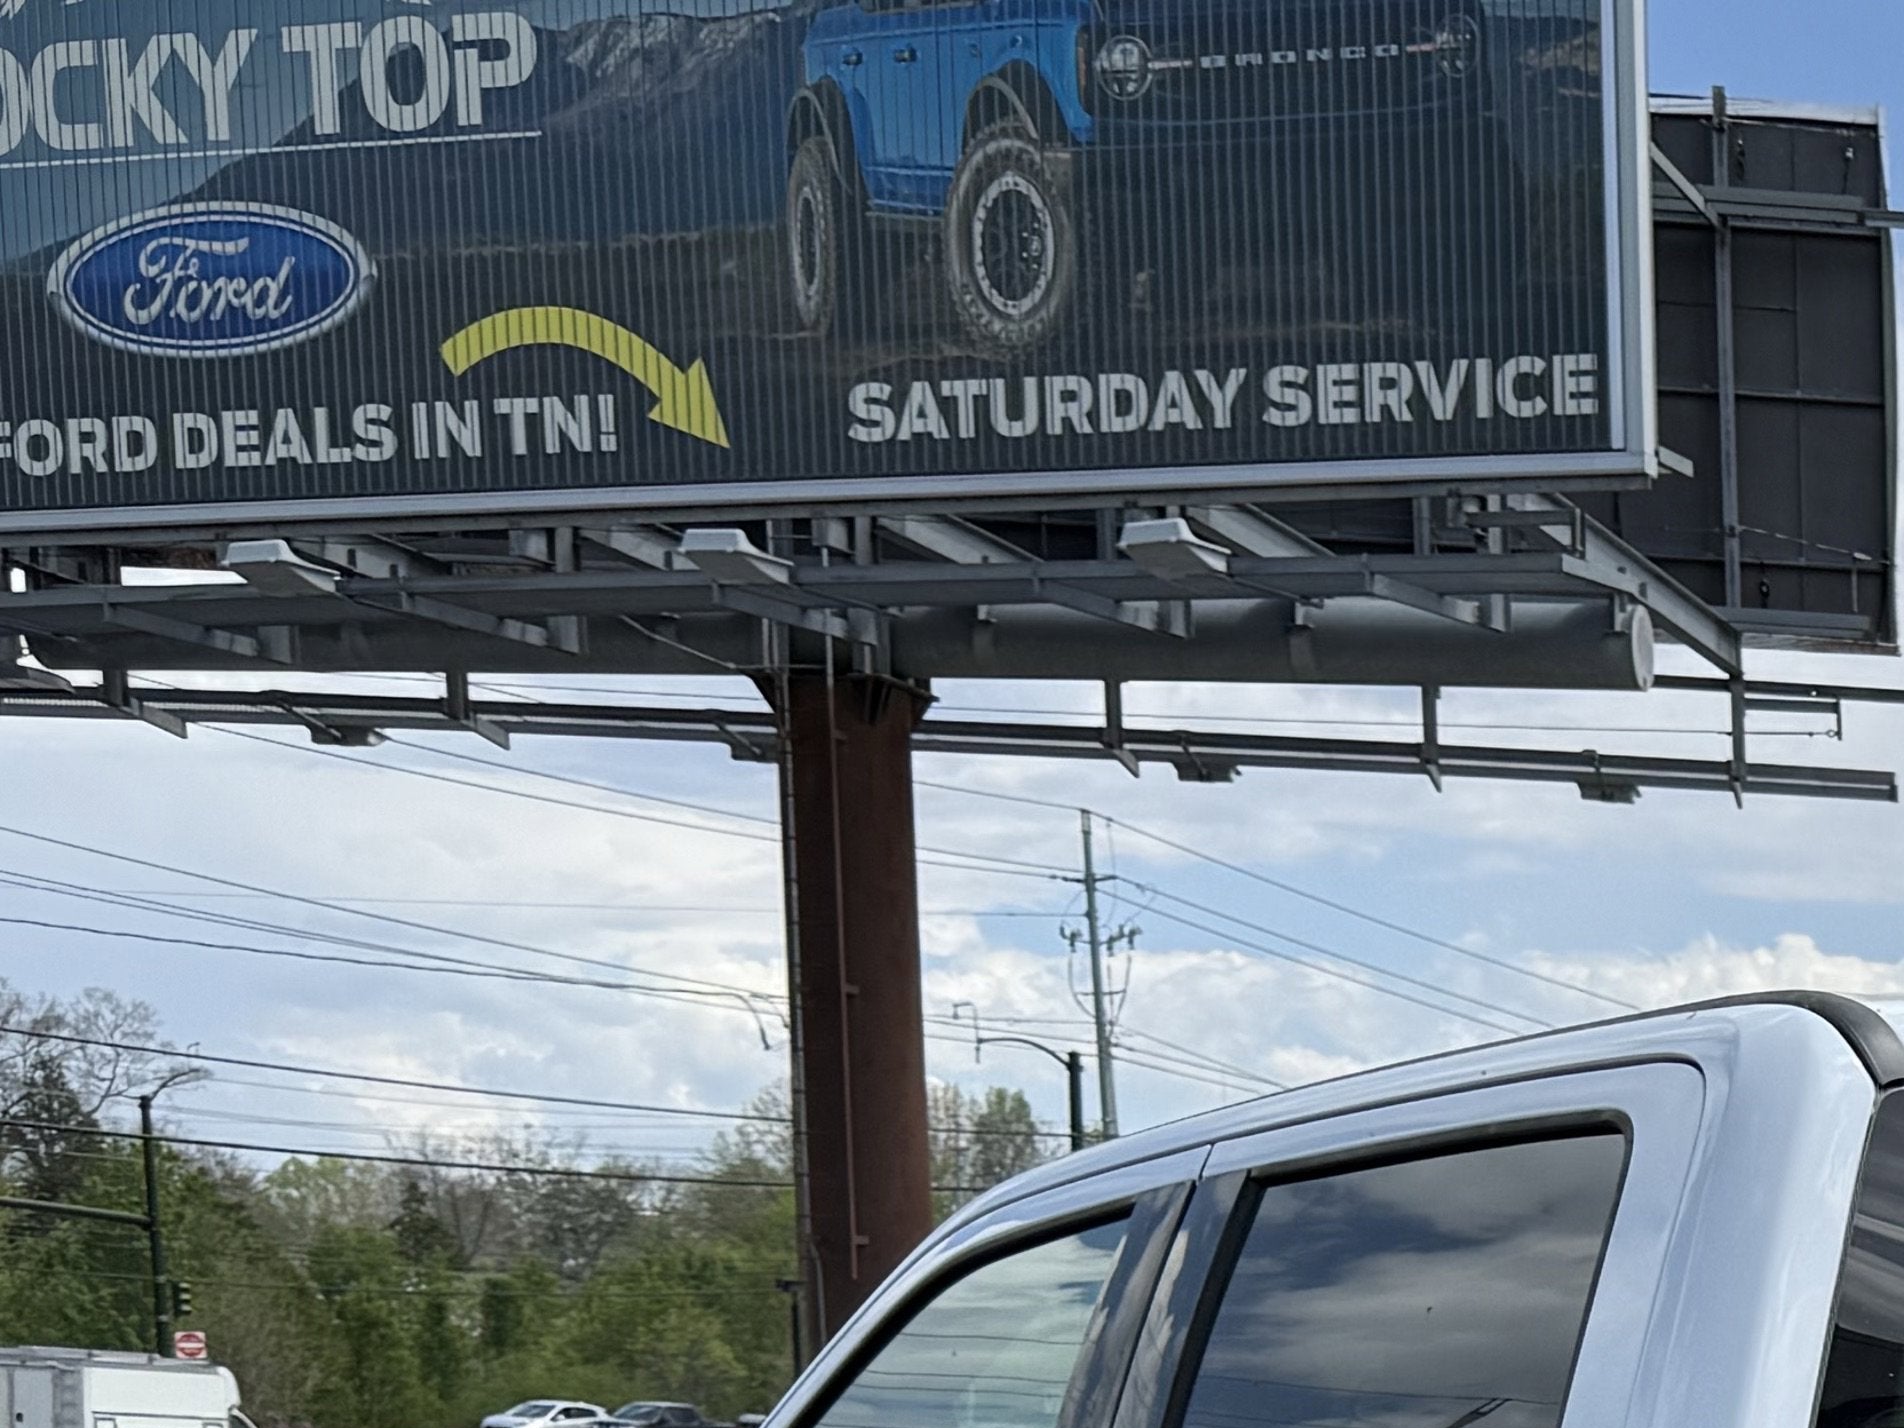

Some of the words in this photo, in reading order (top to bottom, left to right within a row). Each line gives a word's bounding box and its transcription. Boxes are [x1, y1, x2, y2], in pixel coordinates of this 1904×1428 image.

[281, 11, 538, 135] TOP
[123, 236, 296, 325] Ford
[172, 404, 398, 469] DEALS
[411, 400, 482, 460] IN
[493, 394, 617, 456] TN!
[848, 367, 1247, 442] SATURDAY
[1262, 353, 1598, 427] SERVICE
